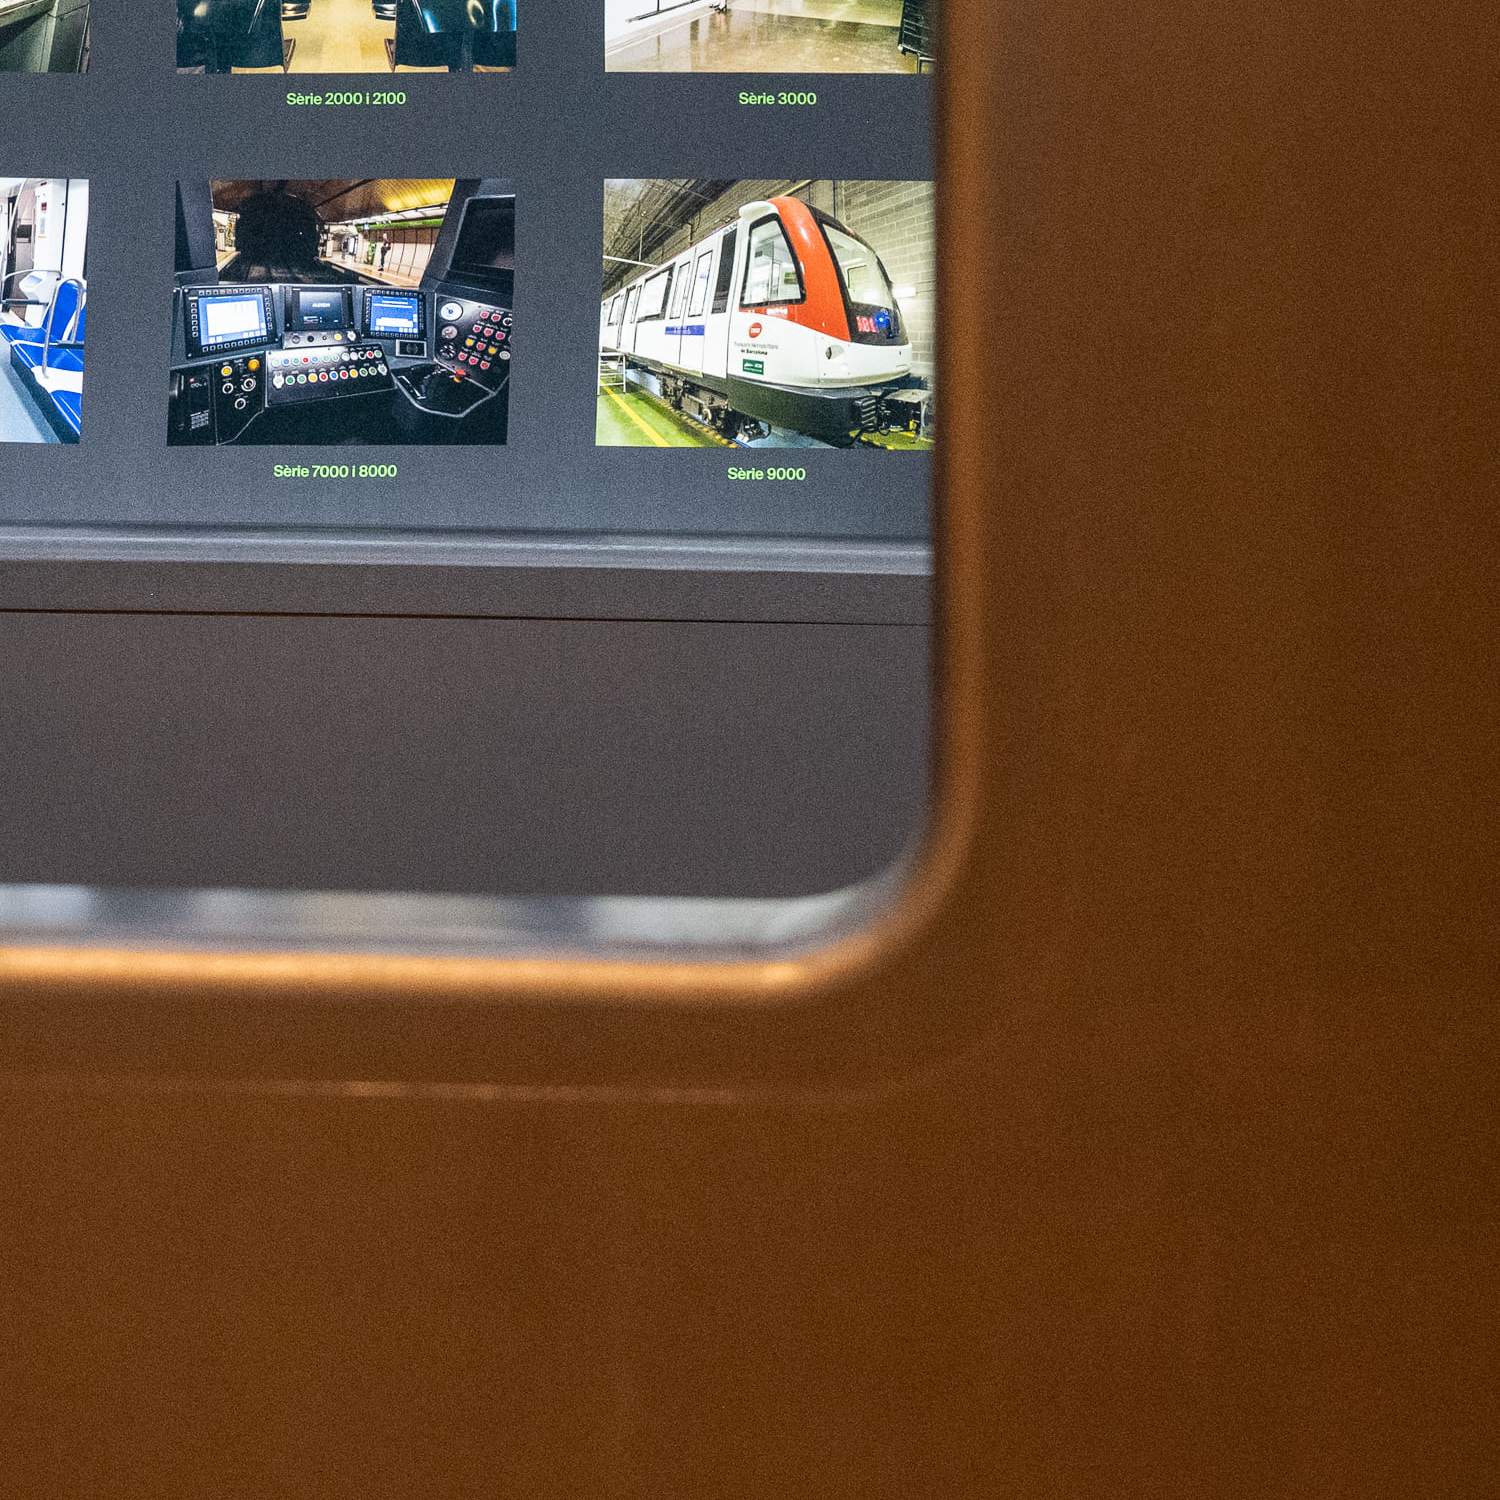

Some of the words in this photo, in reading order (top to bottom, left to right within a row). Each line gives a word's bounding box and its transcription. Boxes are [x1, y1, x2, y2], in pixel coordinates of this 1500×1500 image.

[285, 91, 324, 106] Sèrie
[324, 91, 364, 106] 2000
[366, 91, 370, 105] i
[371, 91, 407, 106] 2100
[738, 91, 776, 106] Sèrie
[777, 91, 818, 106] 3000
[273, 463, 311, 478] Sèrie
[311, 464, 350, 479] 7000
[352, 465, 356, 478] i
[358, 463, 398, 478] 8000
[727, 466, 766, 481] Sèrie
[766, 466, 807, 481] 9000
